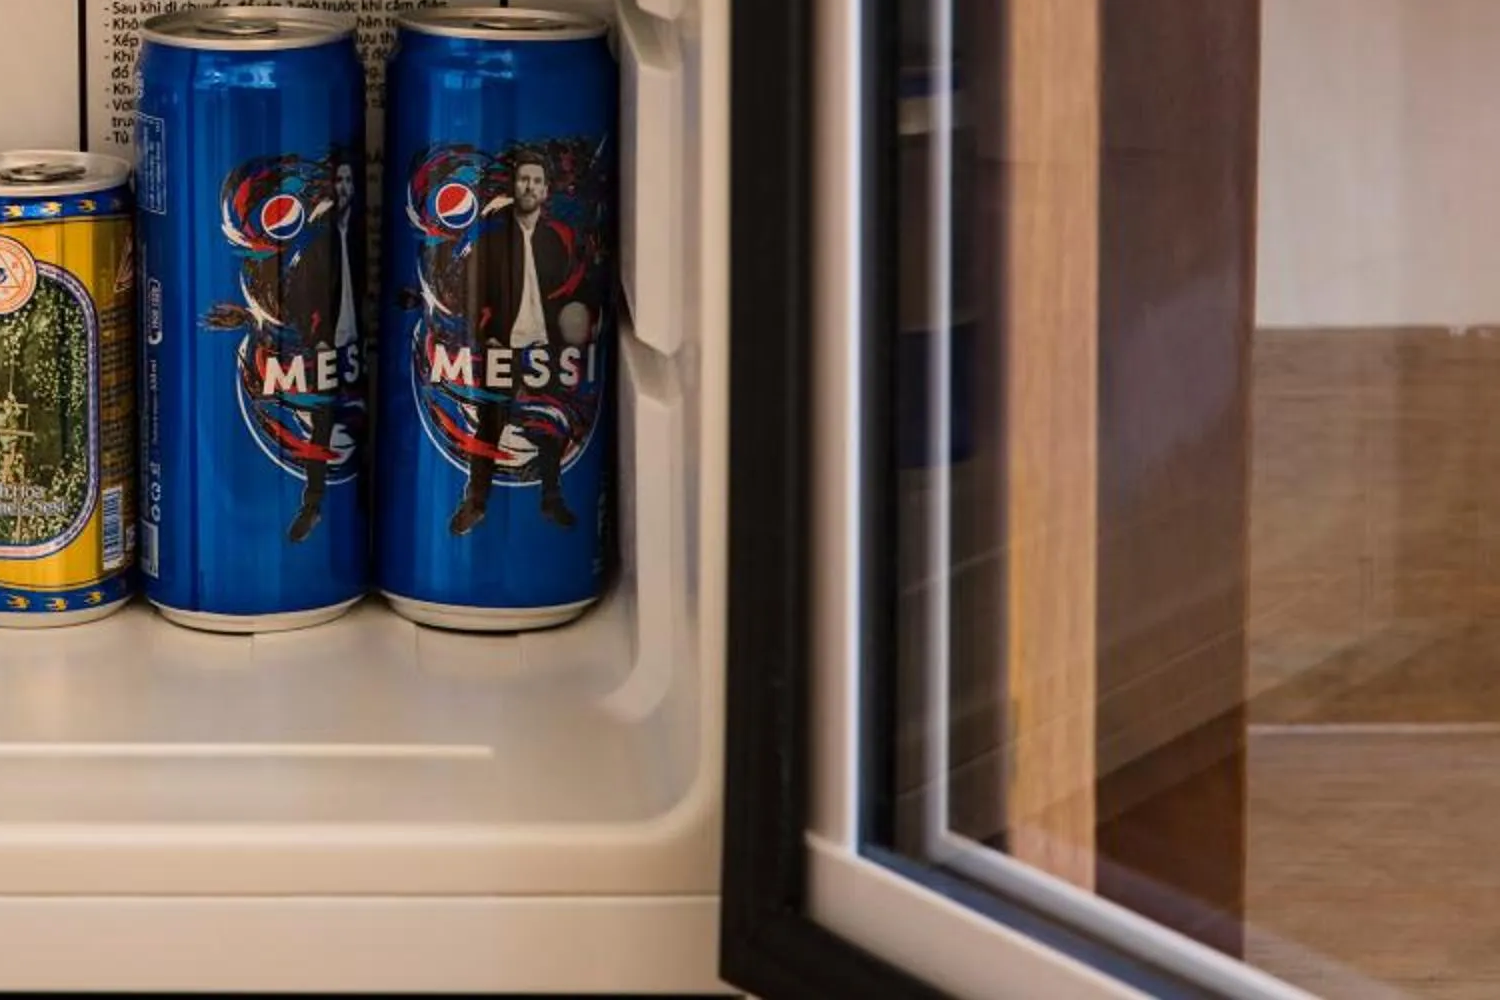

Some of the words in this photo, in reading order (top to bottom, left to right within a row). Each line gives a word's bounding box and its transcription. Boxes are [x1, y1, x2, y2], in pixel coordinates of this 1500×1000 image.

[140, 1, 161, 14] khi
[263, 343, 368, 395] MES
[430, 343, 595, 389] MESSI
